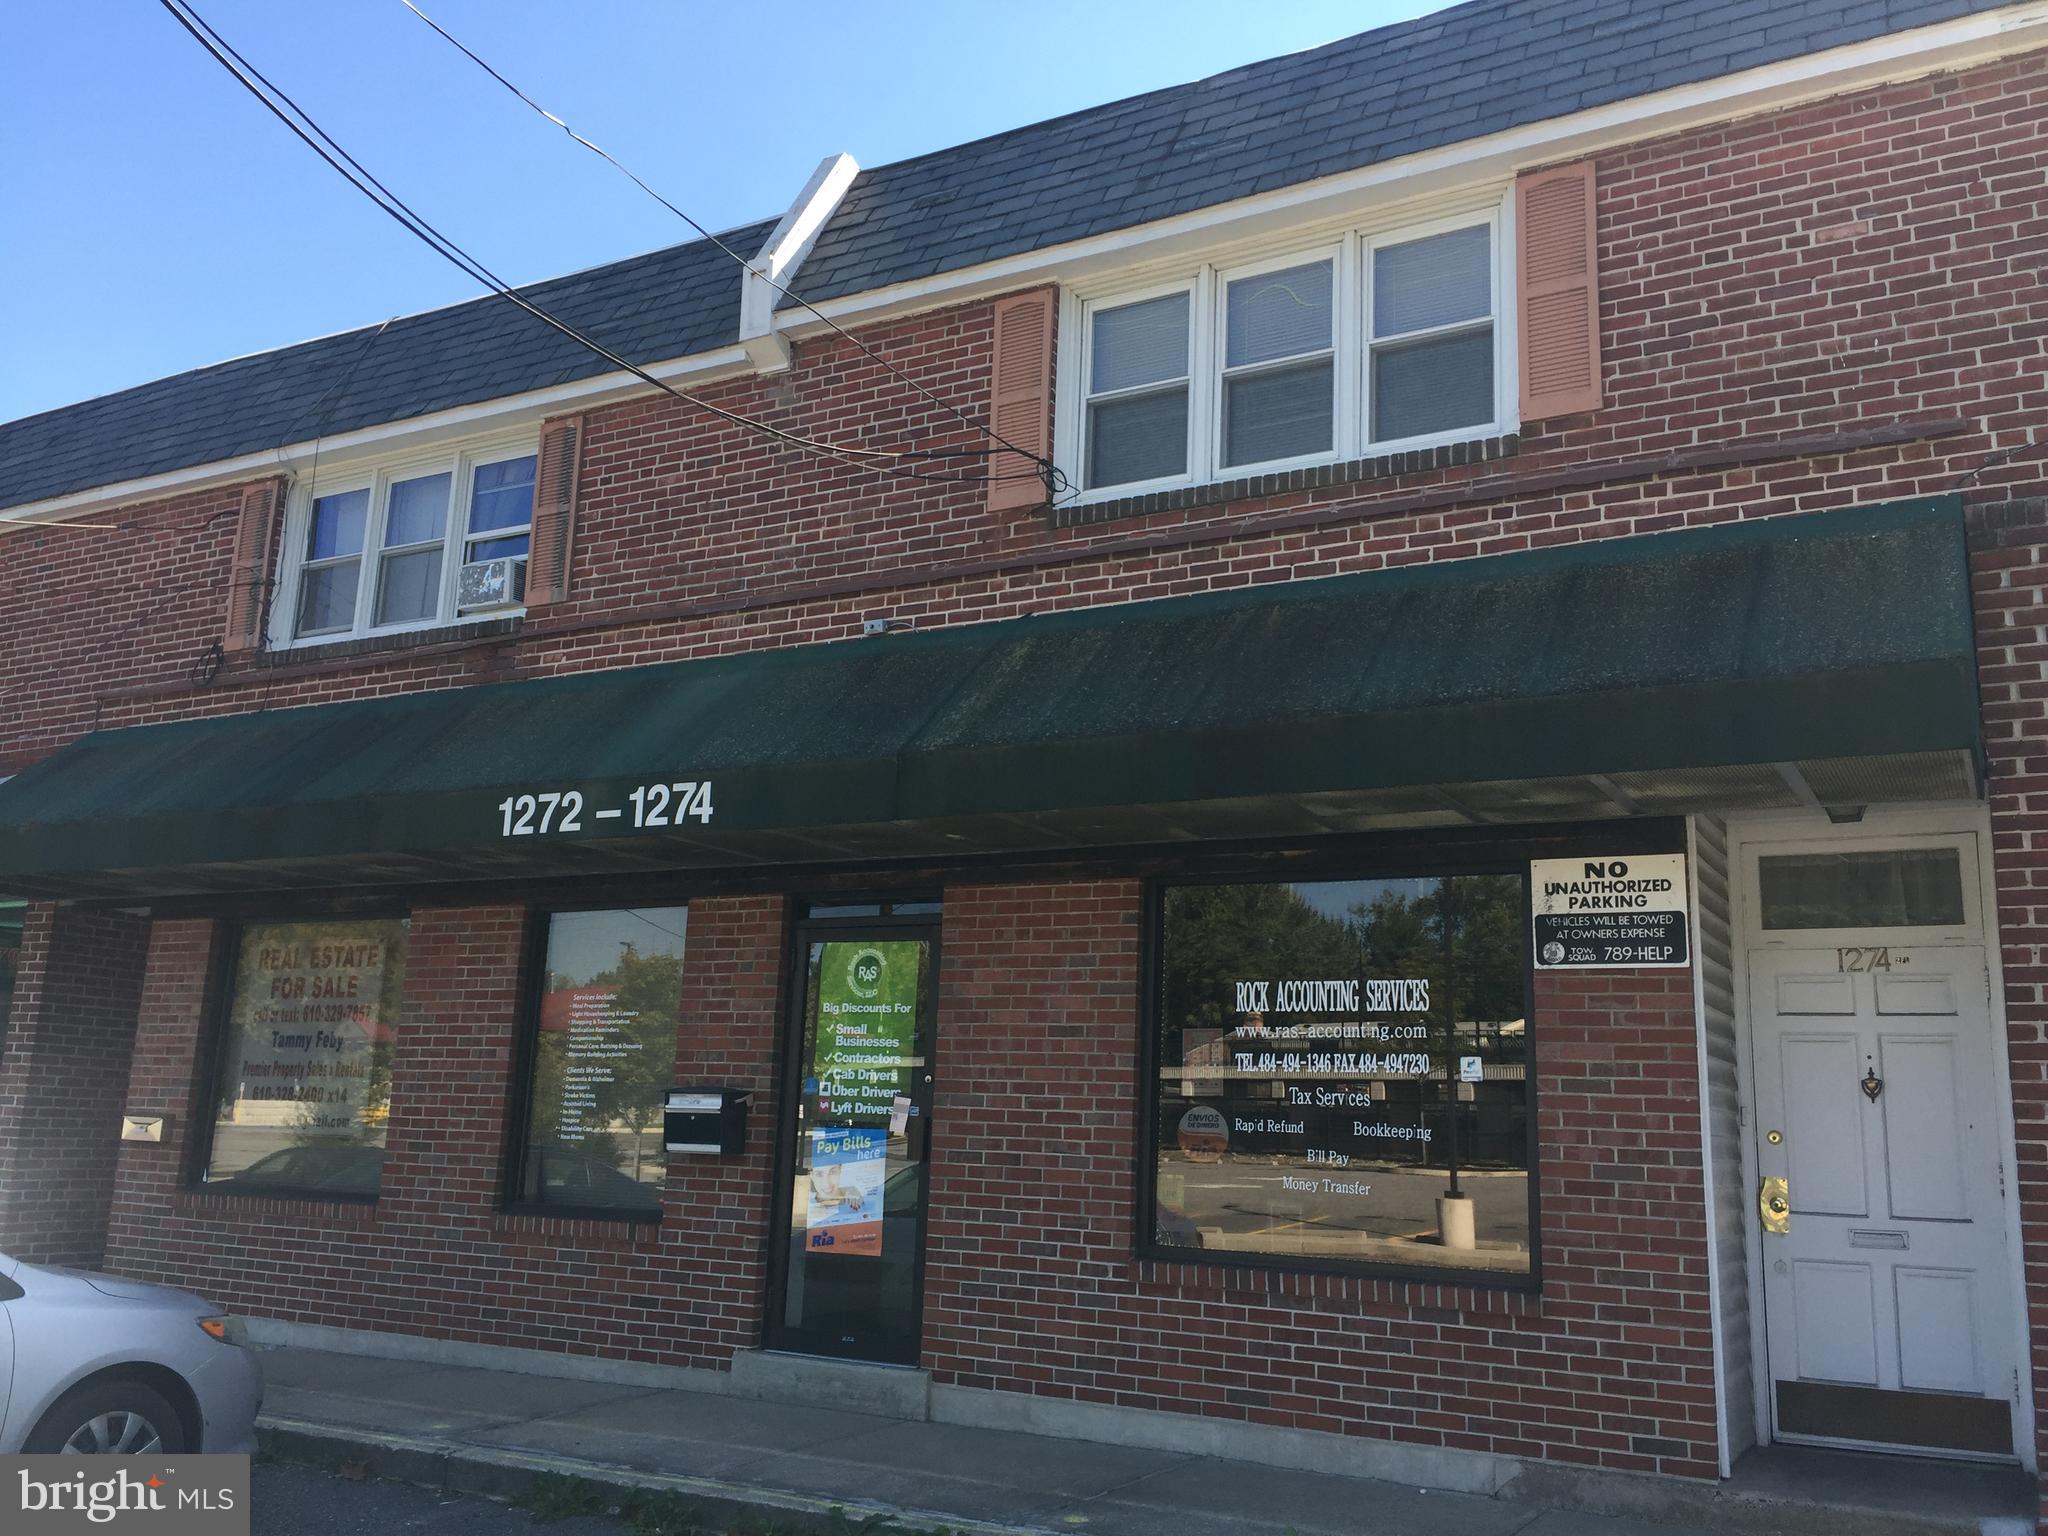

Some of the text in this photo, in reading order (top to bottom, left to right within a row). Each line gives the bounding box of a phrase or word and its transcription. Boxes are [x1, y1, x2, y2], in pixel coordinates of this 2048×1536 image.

[499, 790, 583, 837] 1272
[629, 781, 714, 828] 1274
[1584, 861, 1629, 879] NO
[1544, 879, 1672, 895] UNAUTHORIZED
[1568, 894, 1648, 909] PARKING
[1546, 914, 1673, 927] VEHICLES WILL BE TOWED
[1556, 928, 1665, 939] AT OWNERS EXPENSE
[258, 945, 379, 970] REAL ESTATE
[1570, 947, 1593, 955] TOW
[1604, 946, 1673, 961] 789-HELP
[1836, 947, 1892, 973] 1274
[270, 975, 359, 999] FOR SALE
[573, 993, 595, 1001] Services
[1235, 979, 1430, 1012] ROCK ACCOUNTING SERVICES
[823, 1002, 912, 1014] Big Discounts For
[836, 1023, 867, 1035] Small
[1235, 1023, 1427, 1041] www.ras-accounting.com
[272, 1031, 312, 1052] Tammy
[836, 1036, 900, 1047] Businesses
[834, 1053, 902, 1064] Contractors
[1235, 1053, 1430, 1074] TEL.484-494-1346 FAX.484-4947230
[273, 1060, 304, 1080] Property
[832, 1069, 899, 1081] Cab Drivers
[328, 1087, 348, 1103] x14
[832, 1085, 858, 1097] Uber
[1289, 1086, 1371, 1107] Tax Services
[830, 1101, 895, 1115] Lyft Drivers
[1187, 1114, 1220, 1122] ENVIOS
[1235, 1118, 1304, 1134] Rapid Refund
[1353, 1121, 1432, 1142] Bookkeeping
[817, 1136, 872, 1155] Pay Bills
[857, 1148, 881, 1160] here
[1307, 1149, 1349, 1166] Bill Pay
[1282, 1176, 1371, 1195] Money Transfer
[812, 1231, 835, 1247] Ria
